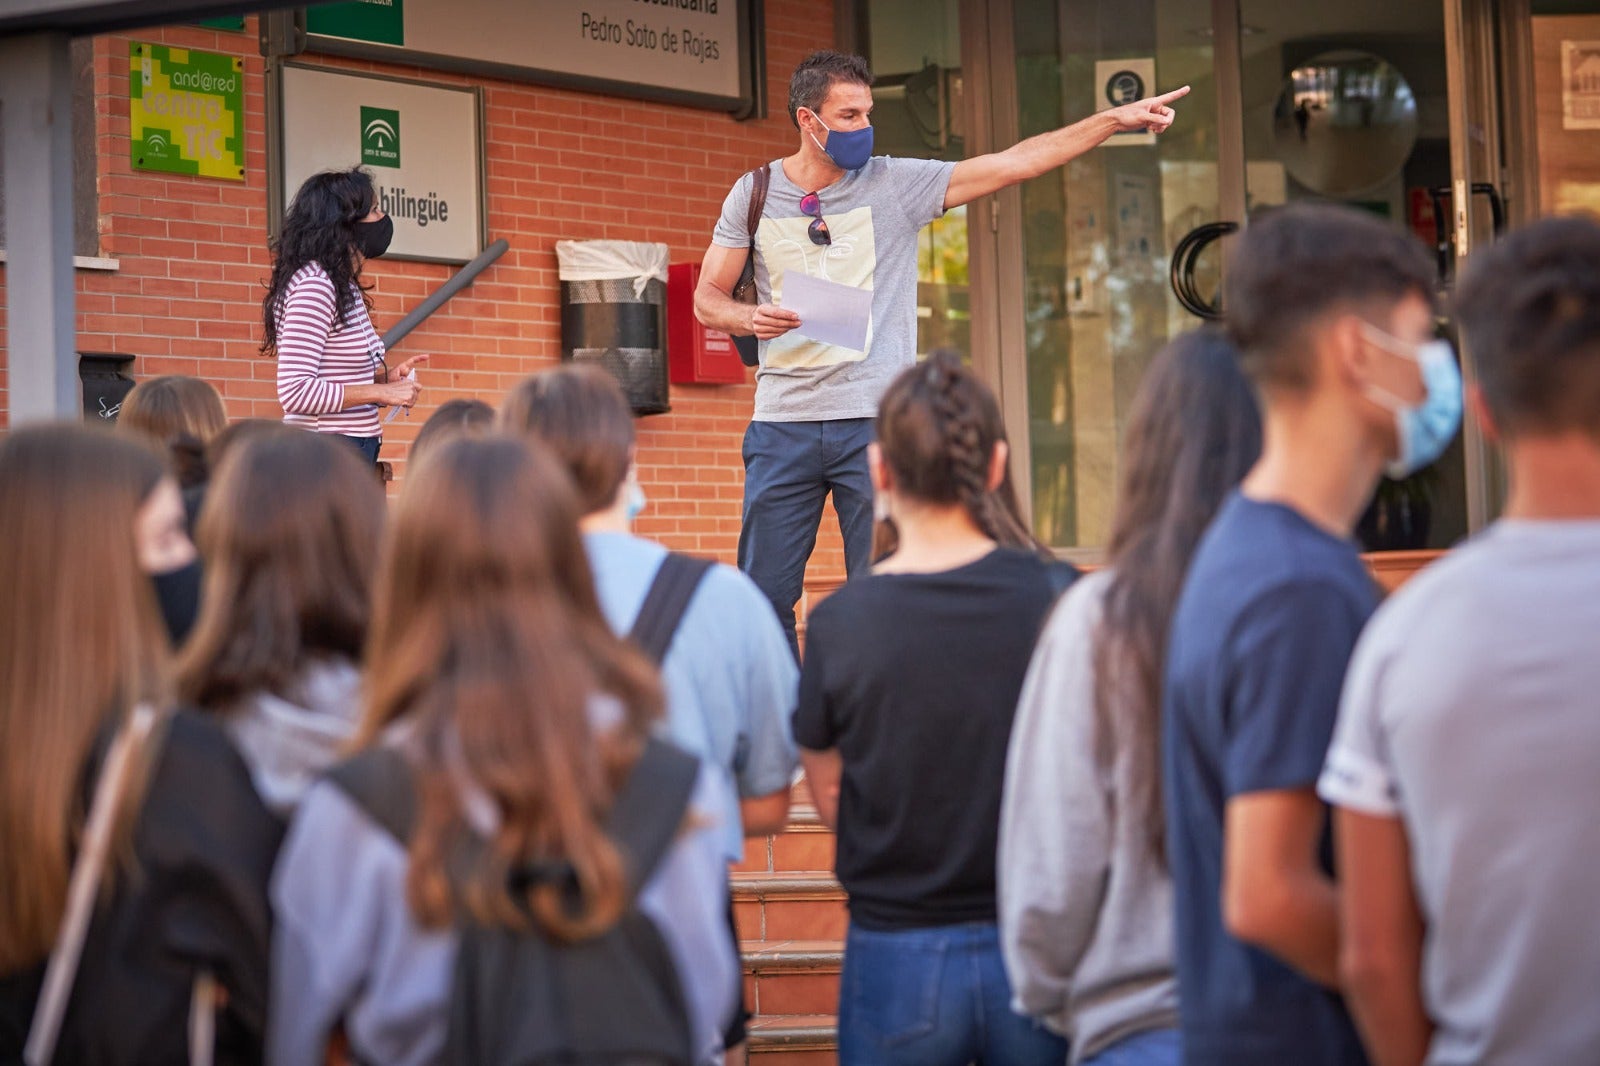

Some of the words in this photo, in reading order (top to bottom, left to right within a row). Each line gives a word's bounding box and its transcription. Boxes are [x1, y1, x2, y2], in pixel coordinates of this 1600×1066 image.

[581, 12, 622, 44] Pedro
[626, 19, 657, 49] Soto
[661, 26, 678, 53] de
[682, 29, 720, 63] Rojas
[173, 69, 235, 92] and@red
[142, 91, 220, 122] centro
[380, 186, 448, 227] bilingüe
